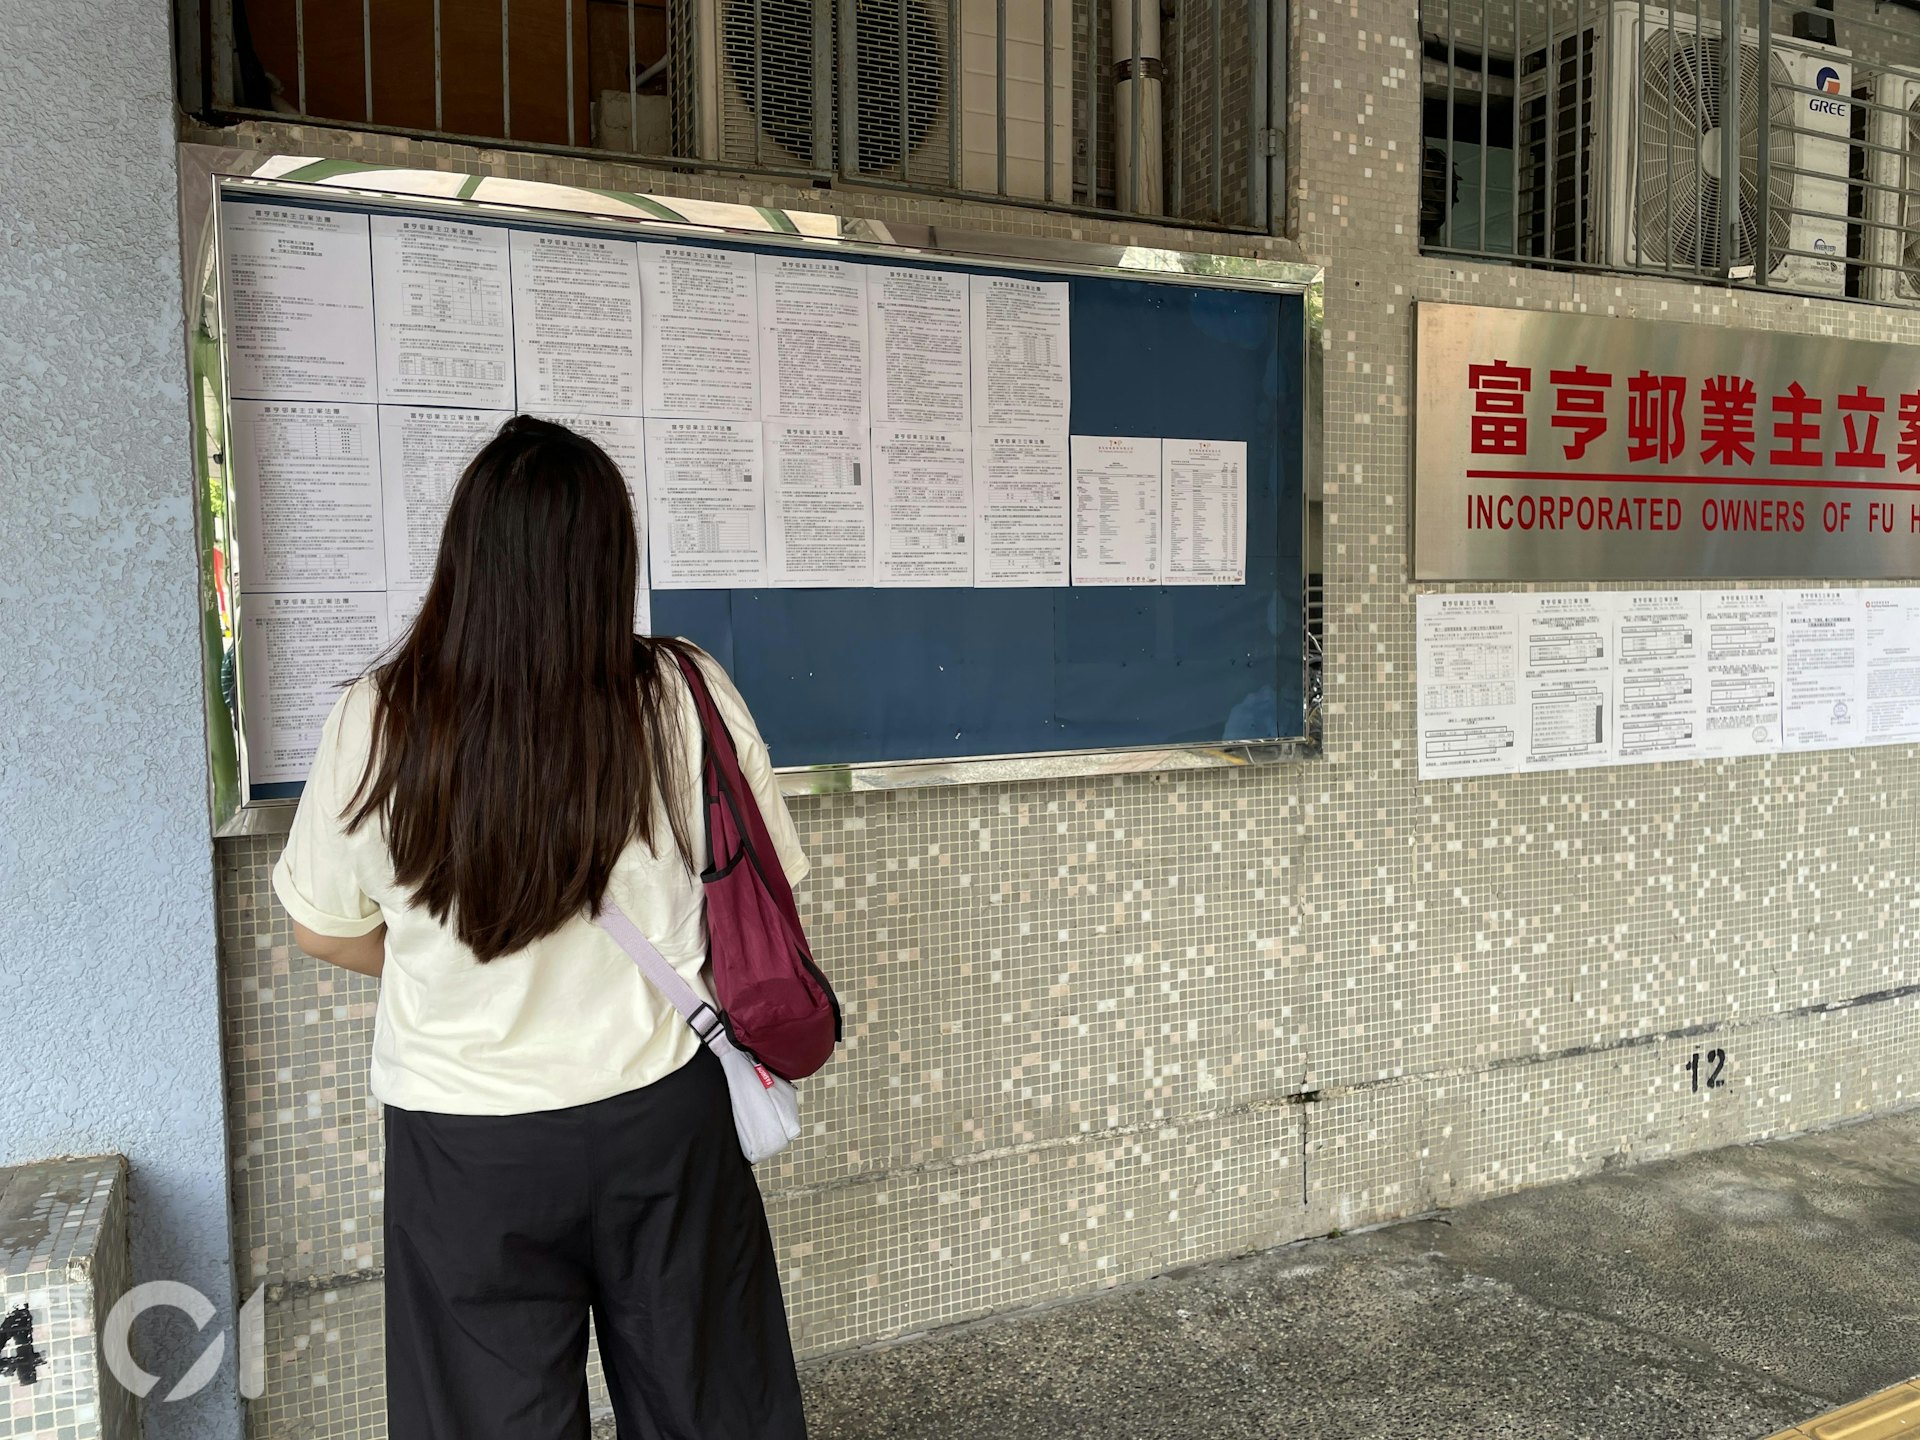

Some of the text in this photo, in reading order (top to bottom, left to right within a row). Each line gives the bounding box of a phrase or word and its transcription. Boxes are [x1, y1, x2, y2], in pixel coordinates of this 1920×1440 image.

[1809, 98, 1846, 117] GREE
[1467, 495, 1682, 531] INCORPORATED
[1702, 498, 1805, 533] OWNERS
[1823, 501, 1851, 533] OF
[1869, 502, 1894, 533] FU
[1685, 1048, 1726, 1094] 12
